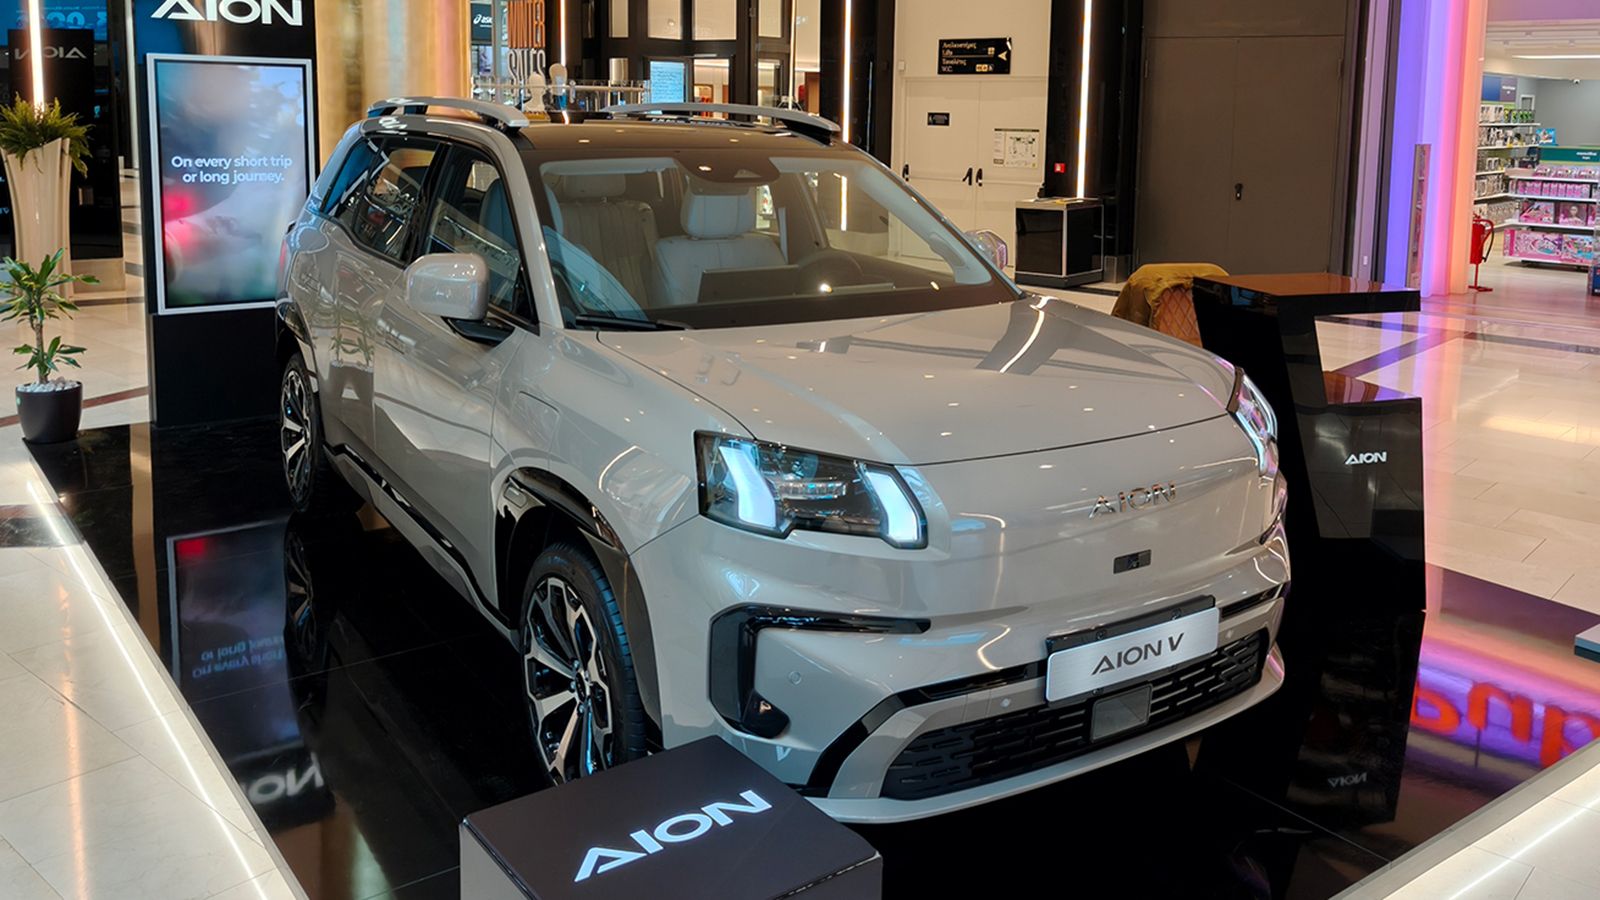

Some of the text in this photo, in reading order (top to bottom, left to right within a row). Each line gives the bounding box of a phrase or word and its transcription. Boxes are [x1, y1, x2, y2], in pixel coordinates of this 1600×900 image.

[150, 0, 303, 26] AION
[171, 155, 293, 169] On every short trip
[182, 170, 284, 184] or long journey.
[1344, 451, 1387, 465] AION
[1088, 481, 1176, 519] AION
[1091, 632, 1185, 676] AION V
[574, 789, 773, 883] AION
